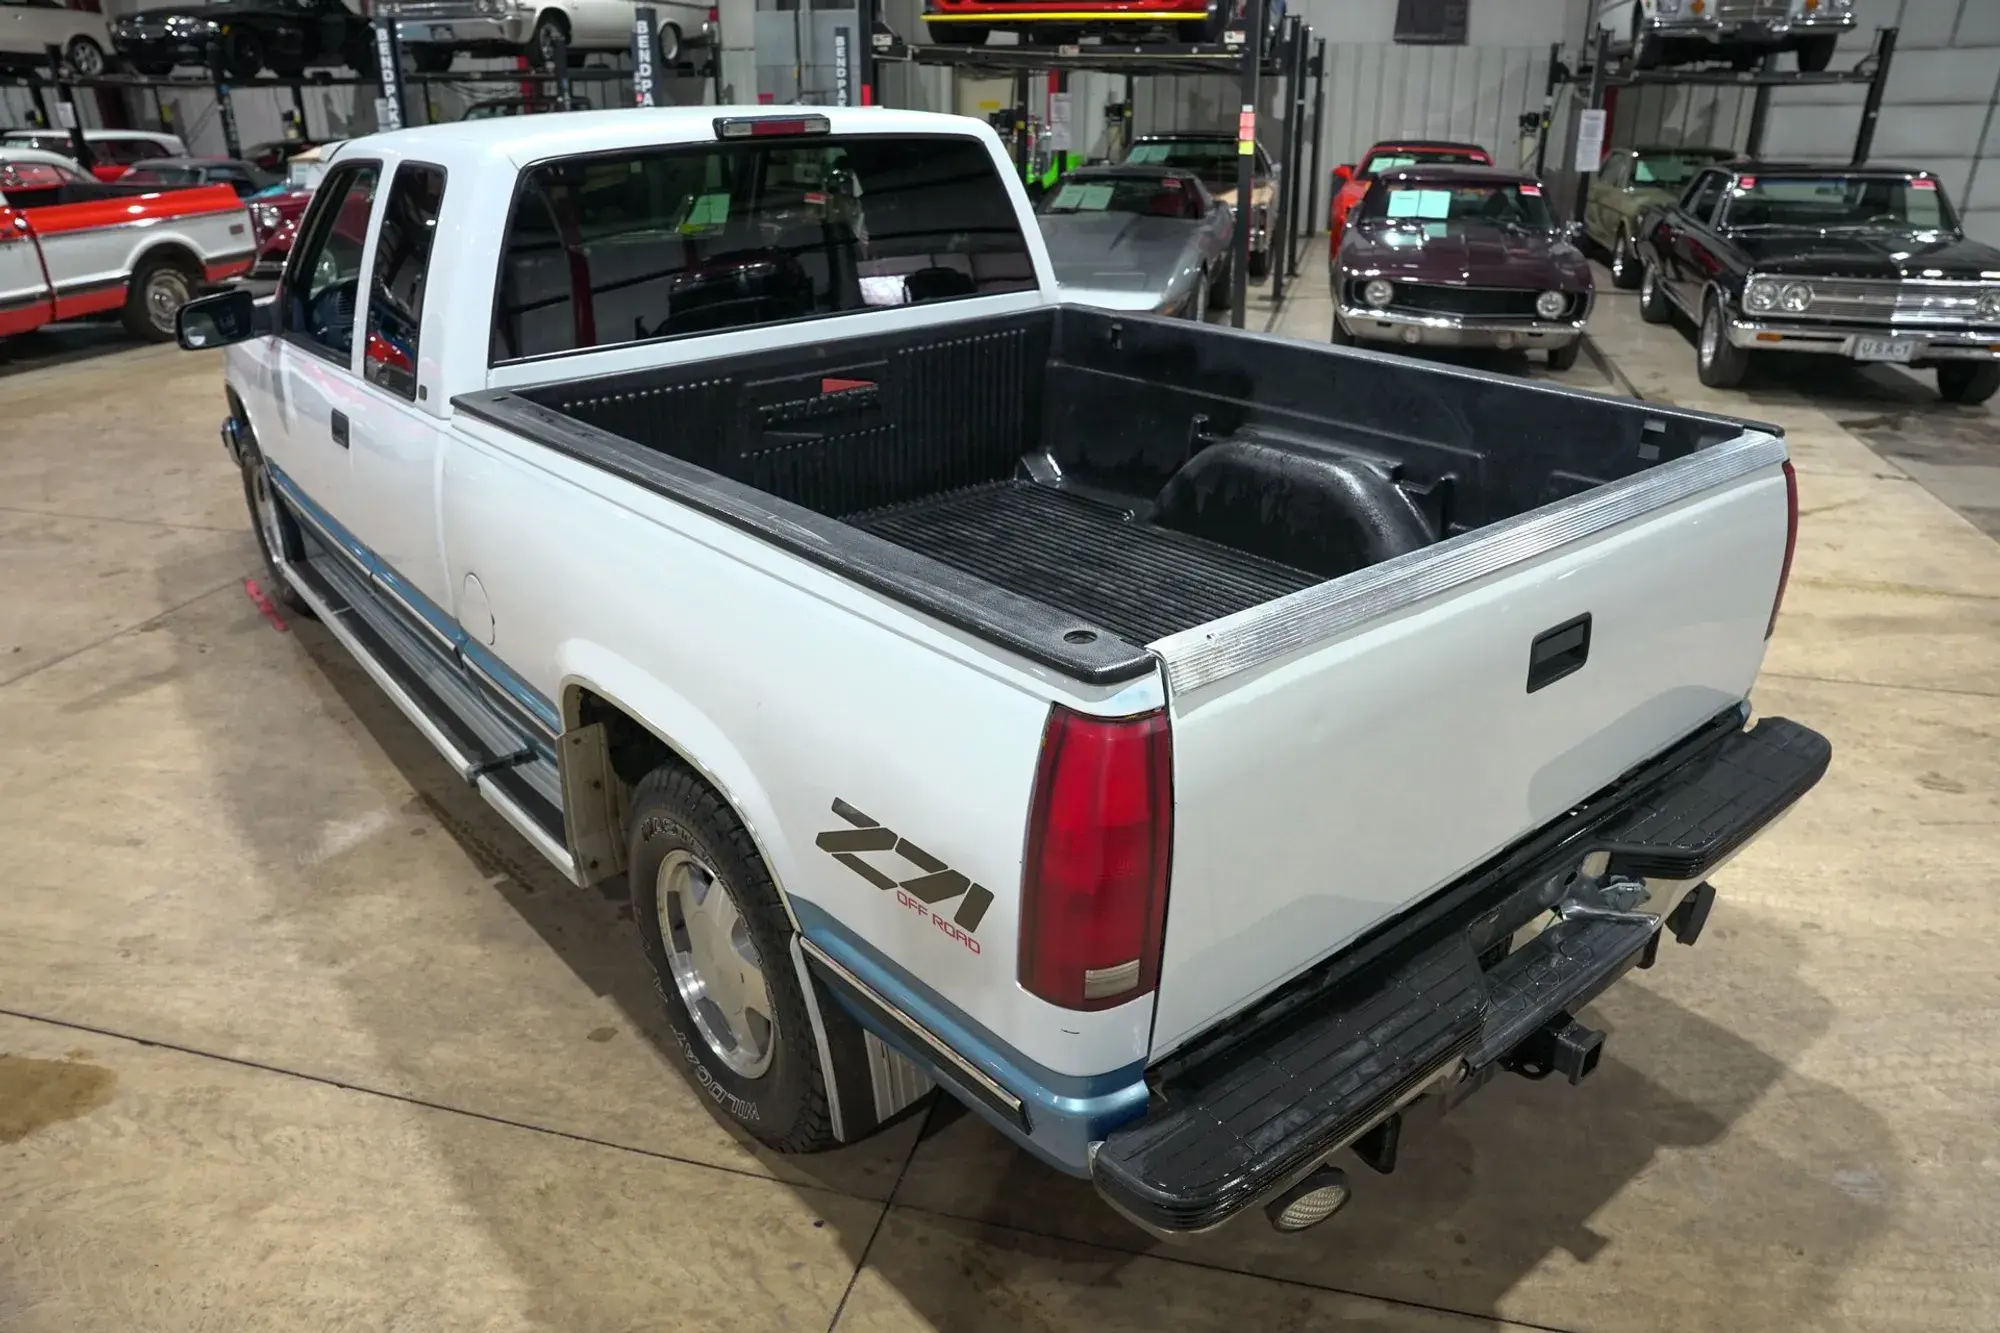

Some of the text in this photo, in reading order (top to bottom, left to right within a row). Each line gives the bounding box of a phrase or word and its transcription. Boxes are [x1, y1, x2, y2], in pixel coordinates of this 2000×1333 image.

[815, 796, 995, 934] Z71
[896, 889, 981, 956] OFF ROAD
[668, 1023, 761, 1121] WILDCAT
